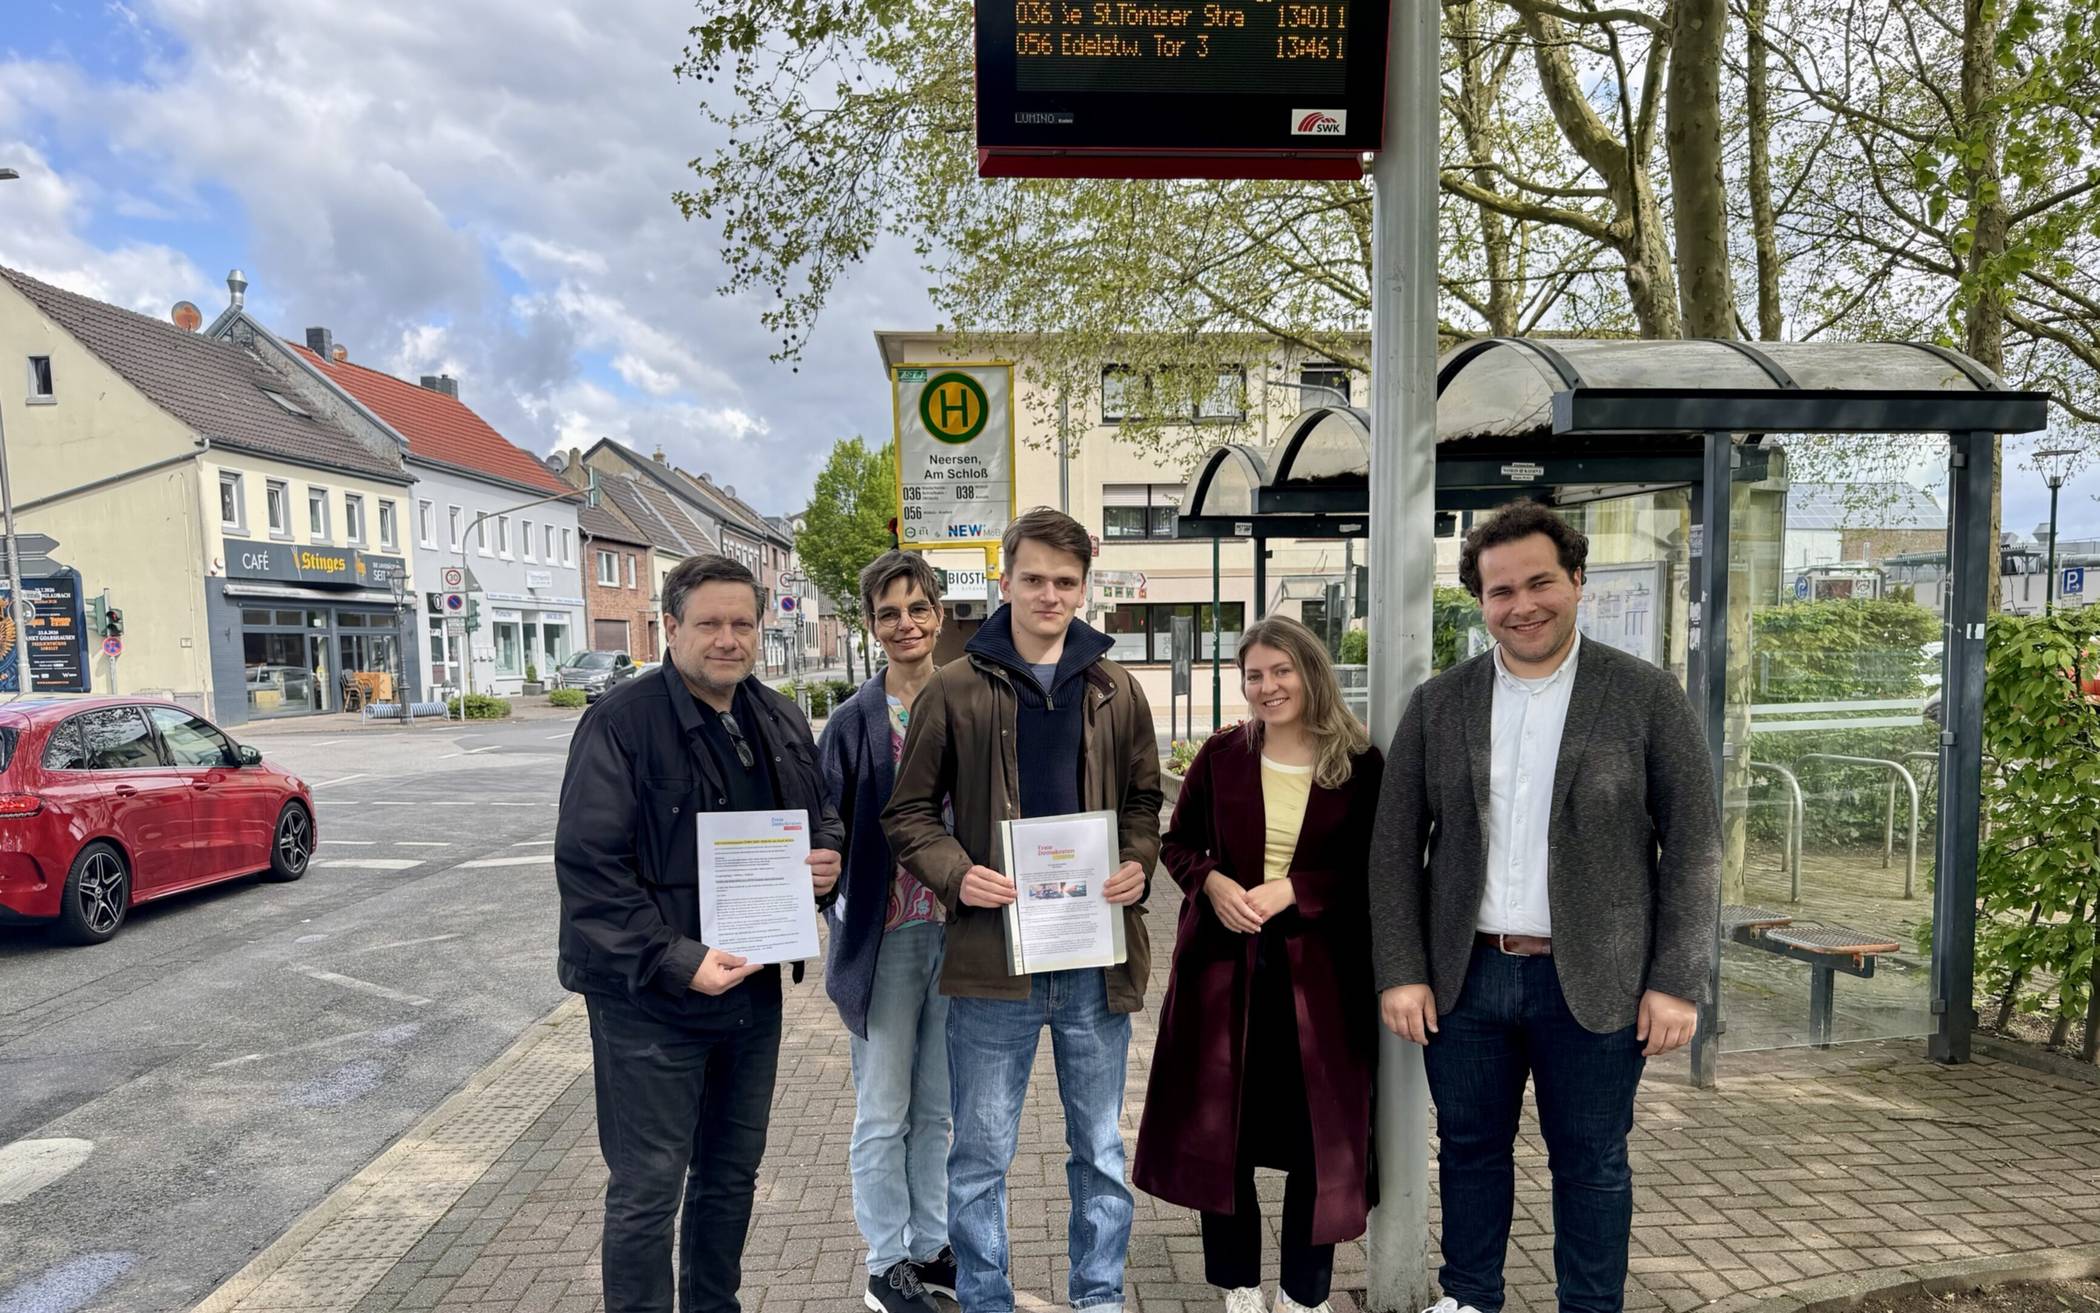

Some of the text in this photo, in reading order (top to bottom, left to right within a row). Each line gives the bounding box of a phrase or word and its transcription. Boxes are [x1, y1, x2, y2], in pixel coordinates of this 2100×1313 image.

[1016, 2, 1052, 24] 036
[1093, 3, 1193, 26] St.Töniser
[1203, 4, 1244, 27] Stra
[1278, 5, 1329, 28] 13:01
[1016, 33, 1052, 55] 056
[1061, 33, 1142, 56] Edelstw.
[1153, 34, 1186, 57] Tor
[1197, 35, 1209, 57] 3
[1276, 36, 1329, 59] 13:46
[1316, 124, 1340, 133] SWK
[940, 389, 969, 429] H
[929, 454, 982, 465] Neersen,
[924, 467, 989, 480] Am Schloß
[902, 486, 921, 501] 036
[955, 485, 975, 500] 038
[903, 506, 922, 520] 056
[948, 524, 982, 537] NEW
[242, 550, 270, 571] CAFÉ
[301, 551, 346, 573] Stinges
[448, 573, 459, 582] 30
[2066, 571, 2079, 592] P
